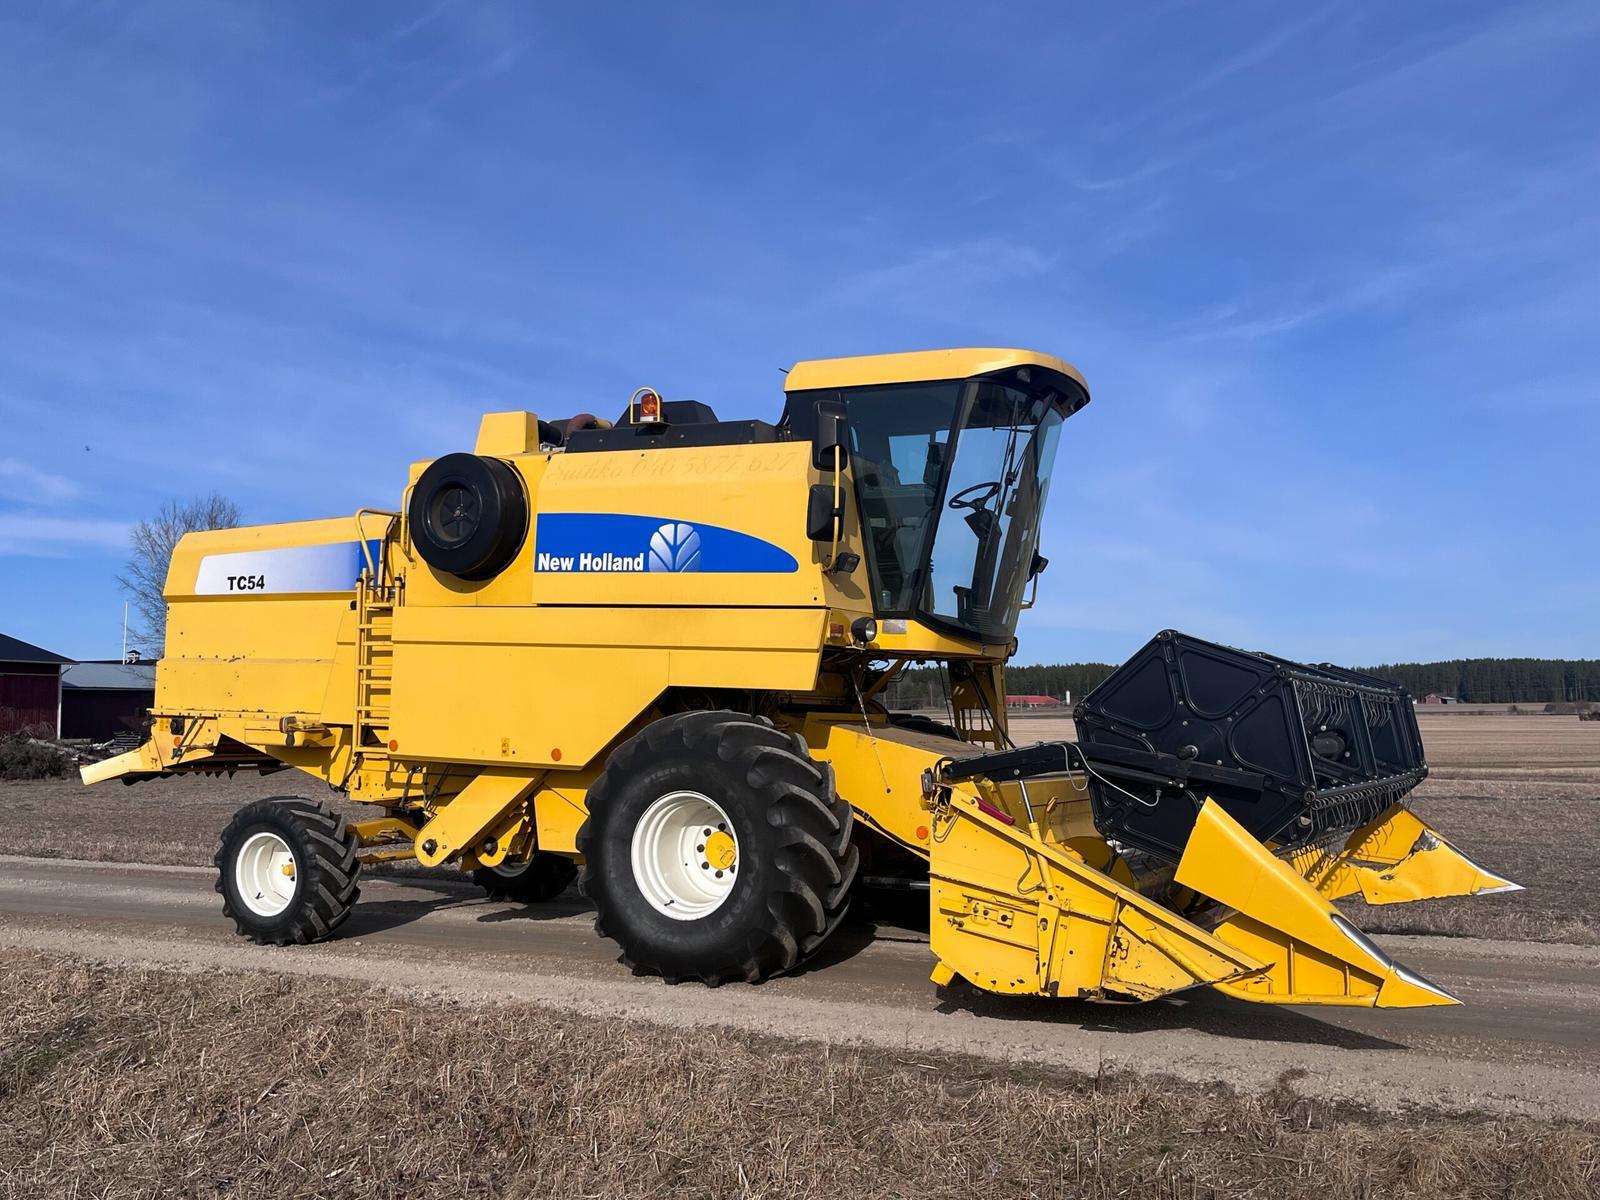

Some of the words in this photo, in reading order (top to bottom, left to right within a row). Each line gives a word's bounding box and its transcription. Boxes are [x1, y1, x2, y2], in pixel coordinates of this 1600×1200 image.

[538, 553, 574, 571] New
[579, 552, 644, 571] Holland
[227, 575, 265, 590] TC54
